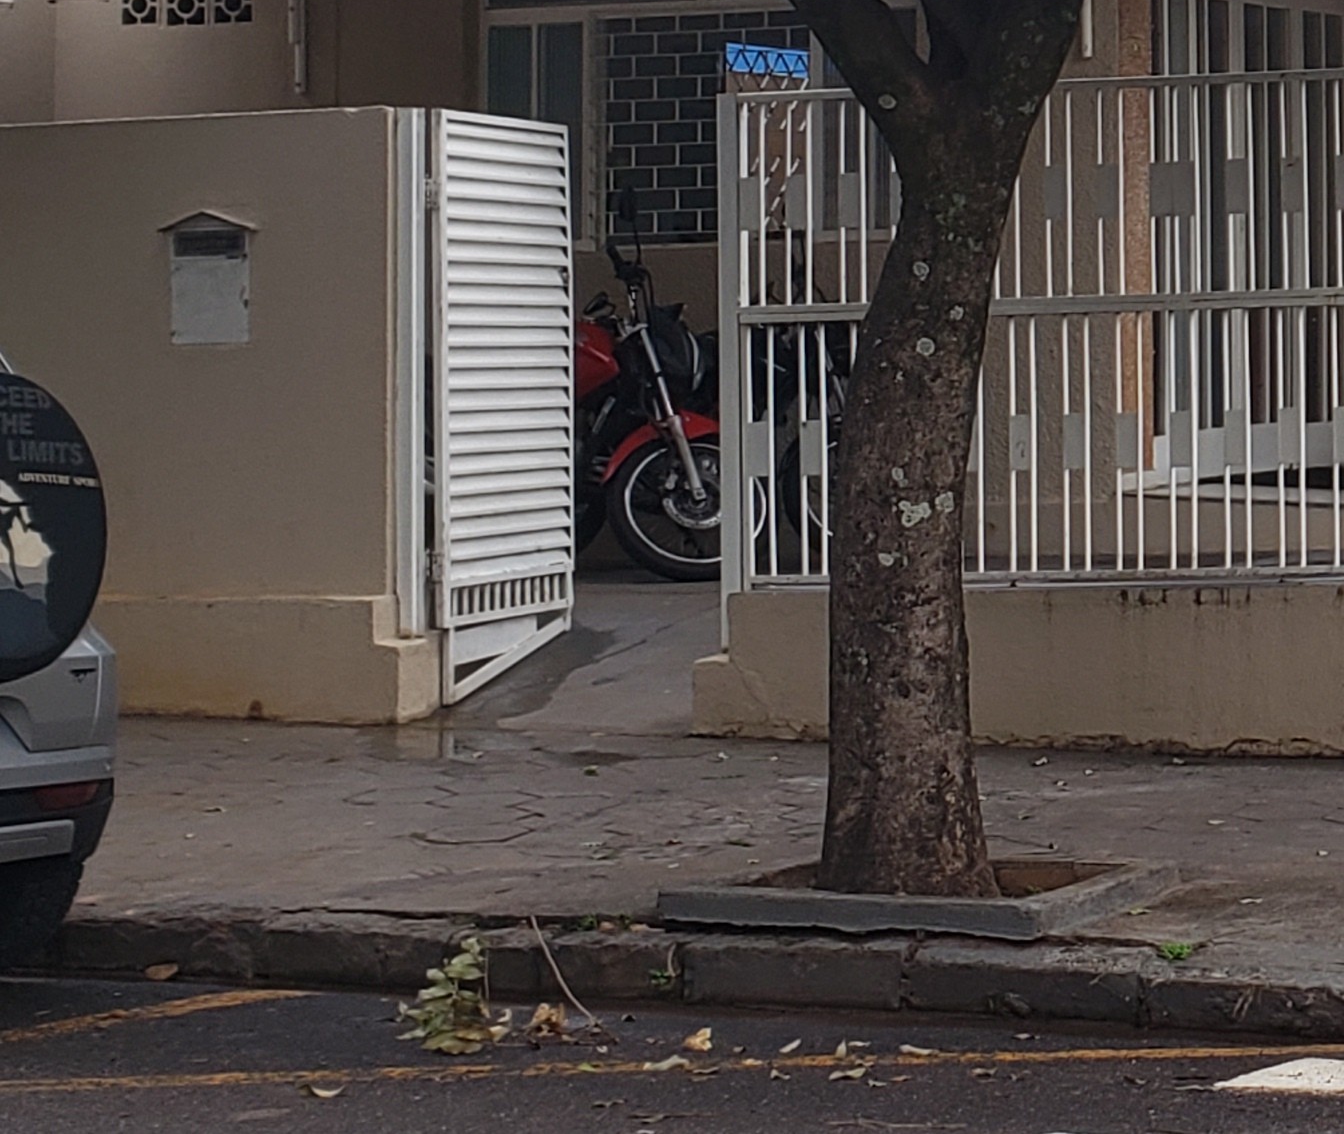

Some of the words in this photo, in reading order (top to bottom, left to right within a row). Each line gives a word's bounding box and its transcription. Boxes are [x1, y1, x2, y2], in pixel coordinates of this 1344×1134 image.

[0, 413, 33, 435] HE
[7, 439, 83, 465] LIMITS
[18, 473, 70, 485] ADVENTURE
